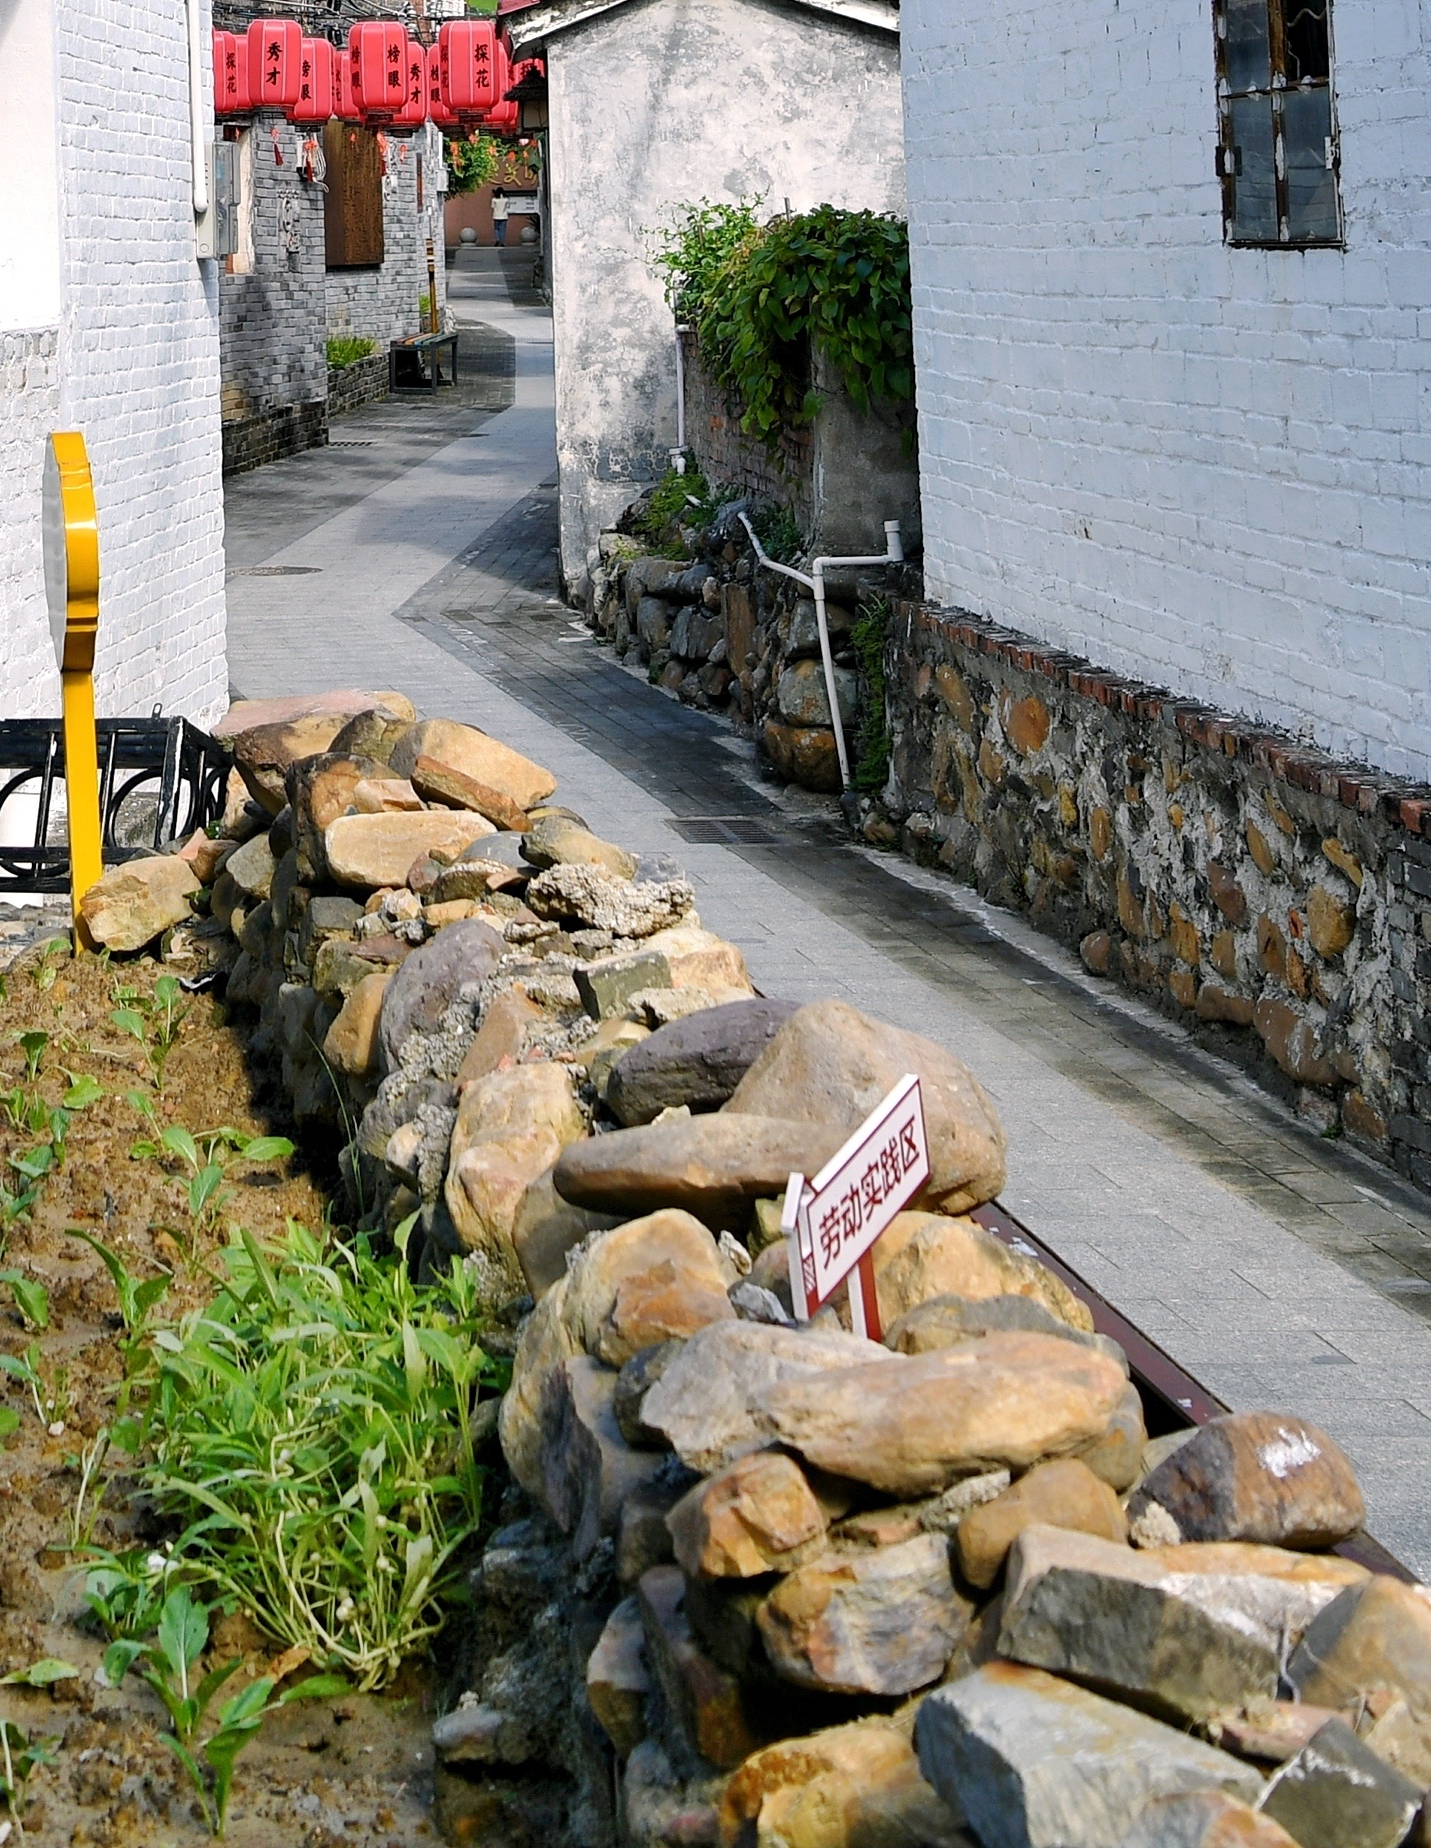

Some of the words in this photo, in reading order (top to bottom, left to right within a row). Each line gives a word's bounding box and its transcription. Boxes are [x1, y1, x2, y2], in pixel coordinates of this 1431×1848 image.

[265, 41, 283, 86] 秀才
[387, 43, 401, 89] 榜眼
[409, 63, 422, 104] 秀才
[474, 43, 490, 89] 探花
[819, 1113, 920, 1271] 劳动实践区
